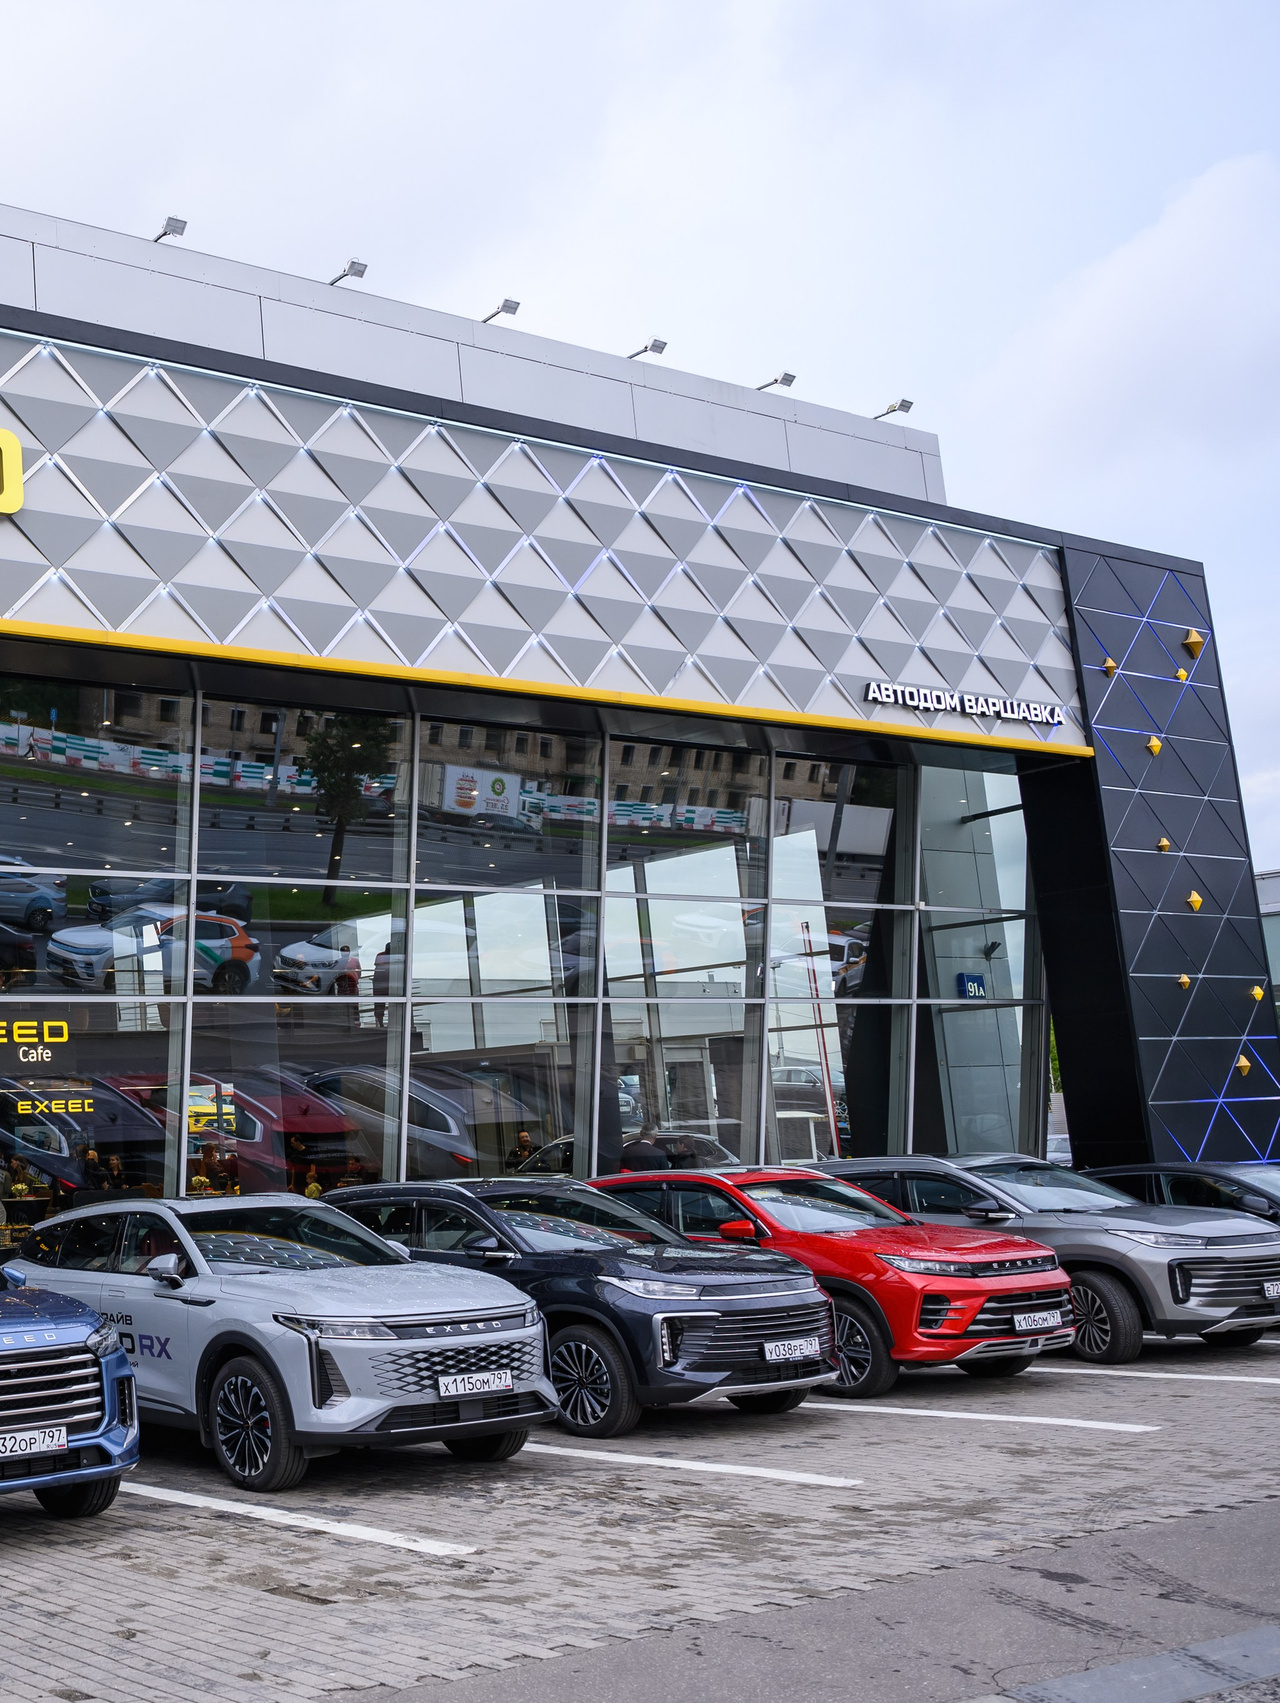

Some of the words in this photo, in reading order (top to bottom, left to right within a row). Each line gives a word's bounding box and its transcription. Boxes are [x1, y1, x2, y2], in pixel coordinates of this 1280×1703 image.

[866, 681, 961, 712] АВТОДОМ
[963, 694, 1066, 725] ВАРШАВКА
[19, 1045, 52, 1062] Cafe
[1266, 1283, 1280, 1296] Е72
[425, 1321, 502, 1334] EXEED
[1016, 1314, 1049, 1329] Х106ОМ
[1048, 1311, 1059, 1322] 797
[138, 1333, 173, 1360] RX
[767, 1342, 804, 1358] У038РЕ
[803, 1338, 817, 1350] 797
[442, 1375, 491, 1394] Х115ОМ
[490, 1371, 509, 1384] 797
[39, 1428, 63, 1445] 797
